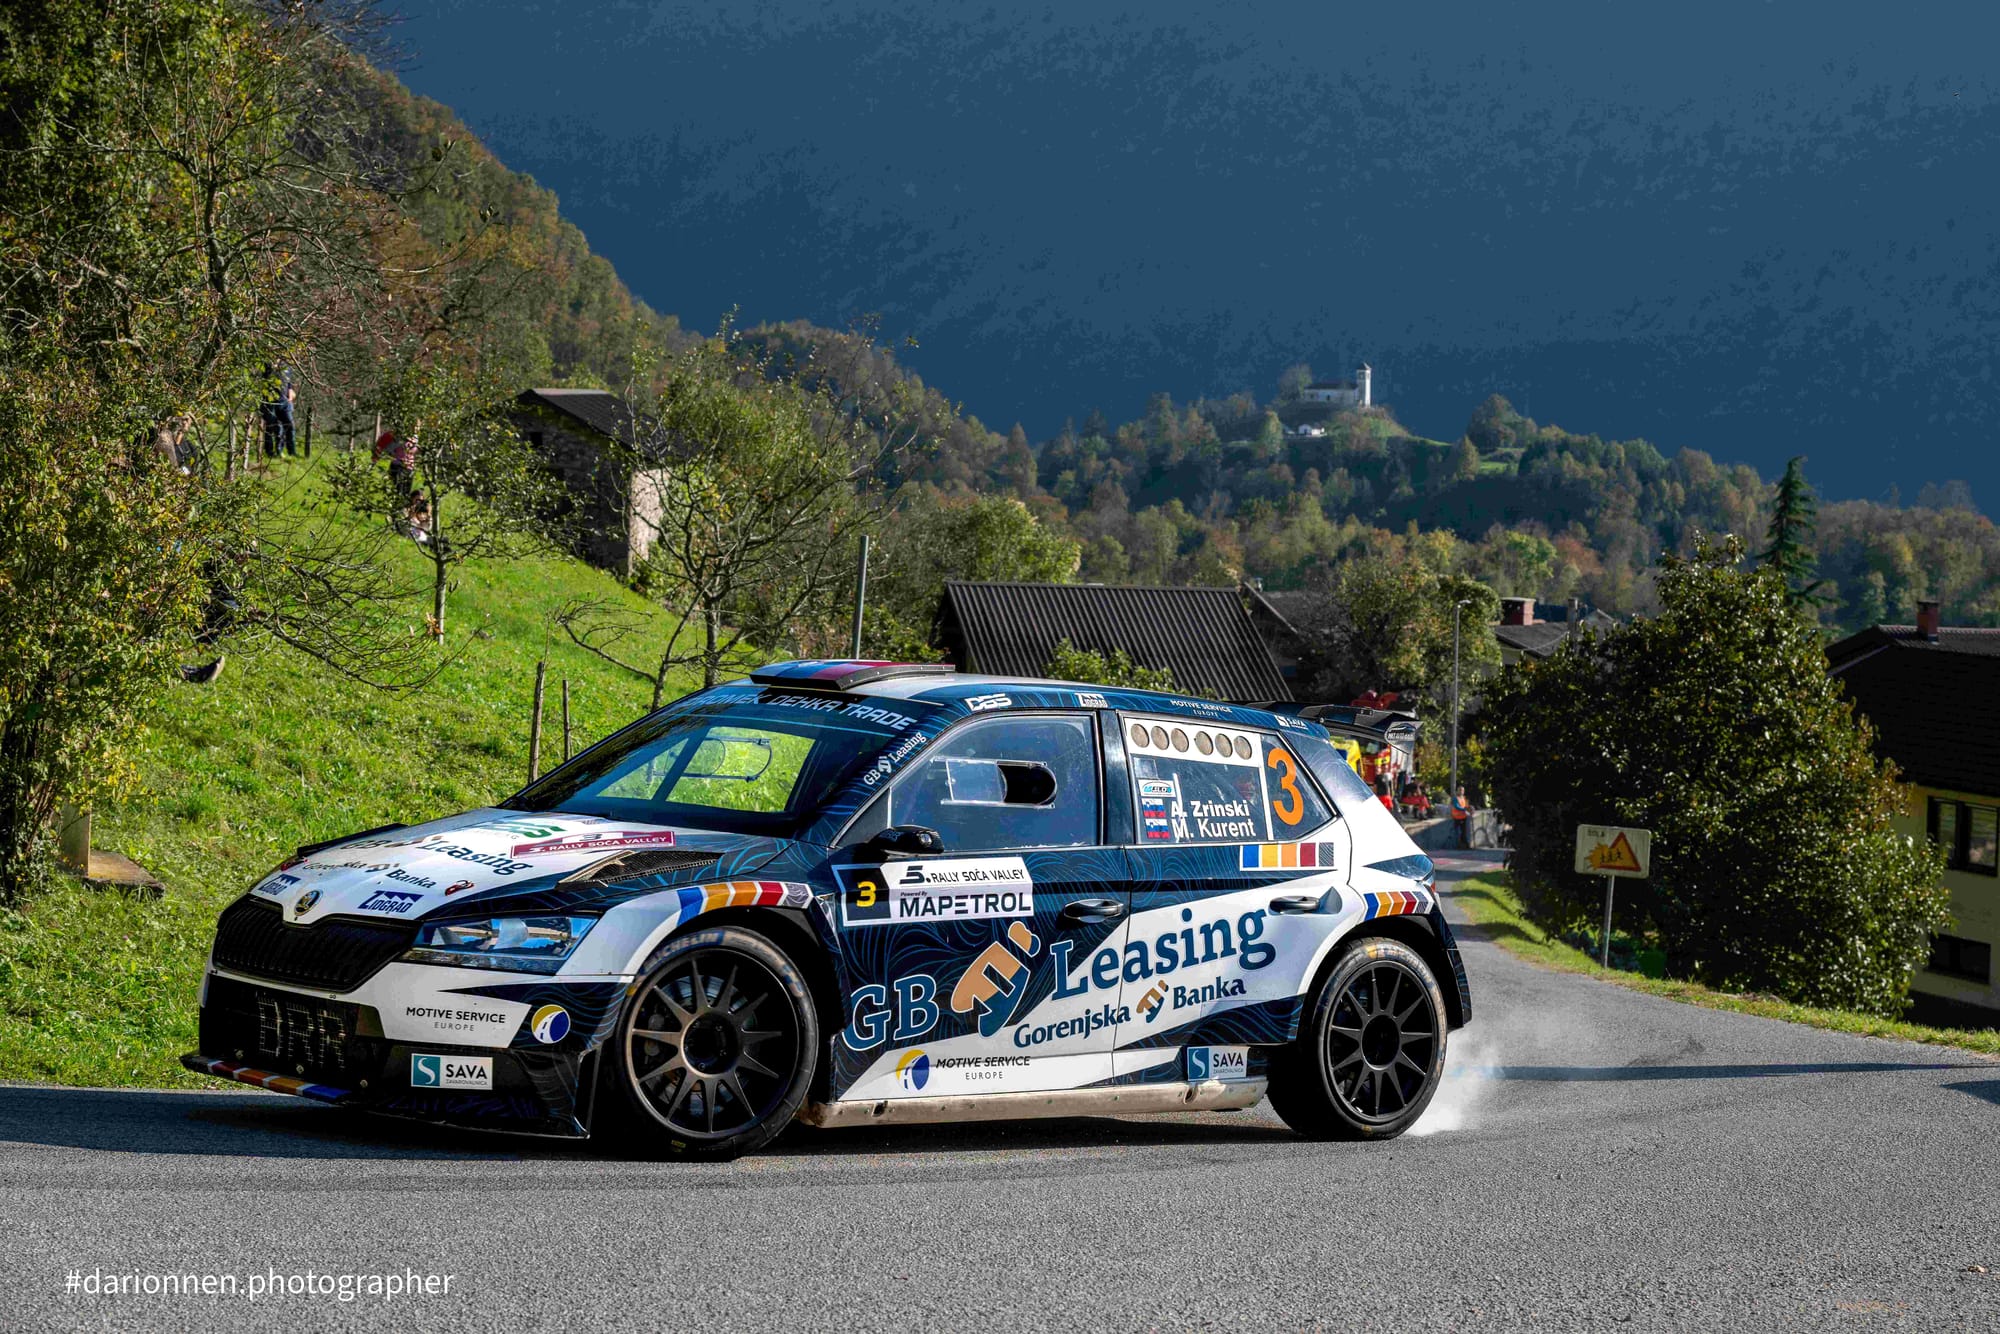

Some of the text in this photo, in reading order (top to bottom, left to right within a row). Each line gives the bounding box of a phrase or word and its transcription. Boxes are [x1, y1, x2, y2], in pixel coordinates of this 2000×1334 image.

[1170, 699, 1201, 709] MOTIVE
[839, 703, 918, 731] TRADE
[863, 732, 927, 785] GB Leasing
[1267, 748, 1304, 826] 3
[1171, 799, 1250, 818] A. Zrinski
[1172, 819, 1257, 839] M. Kurent
[549, 843, 584, 851] RALLY
[624, 837, 667, 845] VALLEY
[416, 840, 534, 875] Leasing
[386, 869, 437, 888] Banka
[931, 871, 959, 883] RALLY
[964, 868, 988, 882] SOČA
[990, 868, 1025, 880] VALLEY
[358, 890, 424, 913] ZIDGRAD
[856, 881, 877, 908] 3
[899, 893, 1031, 917] MAPETROL
[842, 907, 1276, 1051] GB Leasing
[406, 1007, 506, 1023] MOTIVE SERVICE
[1013, 977, 1247, 1048] Gorenjska Banka
[434, 1021, 475, 1032] EUROPE
[936, 1056, 1031, 1069] MOTIVE SERVICE
[1213, 1053, 1244, 1067] SAVA
[446, 1064, 487, 1079] SAVA
[966, 1072, 1003, 1080] EUROPE
